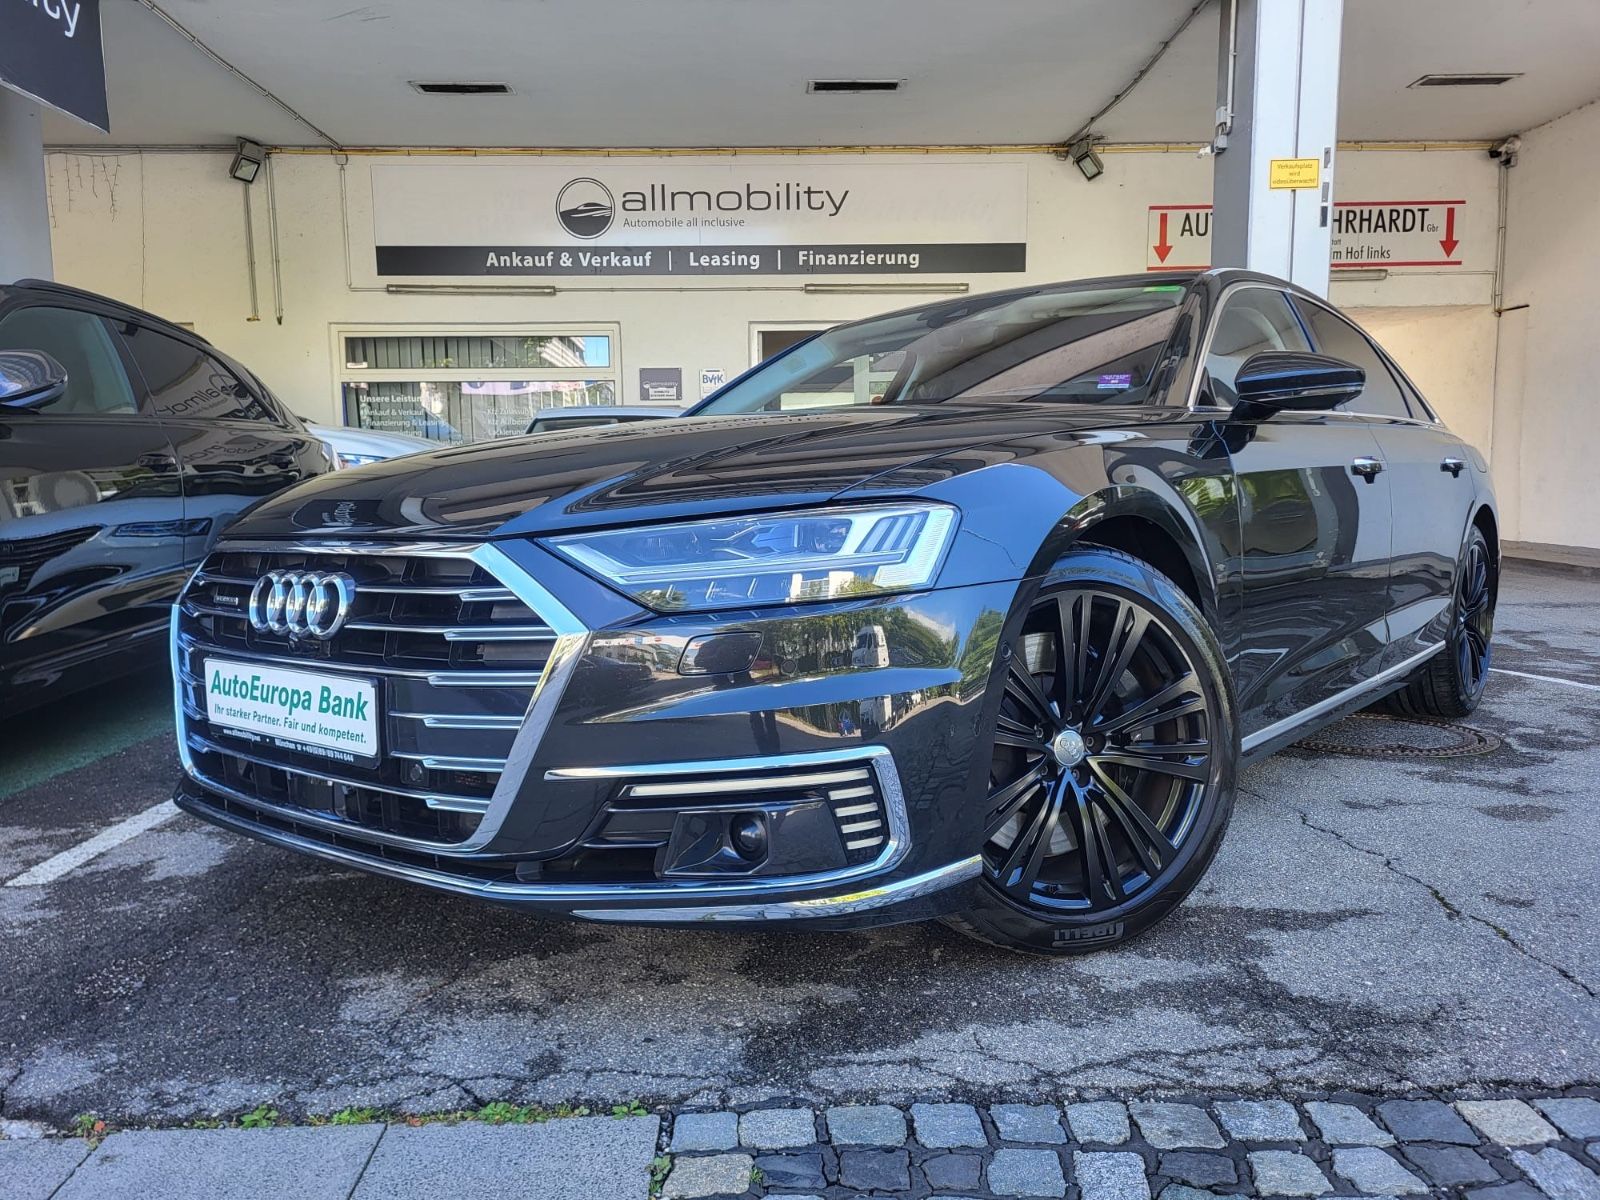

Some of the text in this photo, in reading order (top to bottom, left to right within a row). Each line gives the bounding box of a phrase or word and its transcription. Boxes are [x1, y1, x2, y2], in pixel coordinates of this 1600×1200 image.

[621, 182, 850, 218] allmobility
[623, 216, 746, 228] Automobile all inclusive
[1180, 212, 1213, 237] AU
[1426, 223, 1440, 233] Gbr
[486, 250, 921, 270] Ankauf & Verkauf Leasing Finanzierung
[1345, 245, 1365, 260] Hof
[1366, 245, 1391, 259] links
[360, 394, 390, 403] Unsere
[366, 418, 412, 428] Finanzierung
[210, 669, 369, 722] AutoEuropa Bank
[214, 703, 367, 745] Ihr starker Partner. Fair und kompetent.
